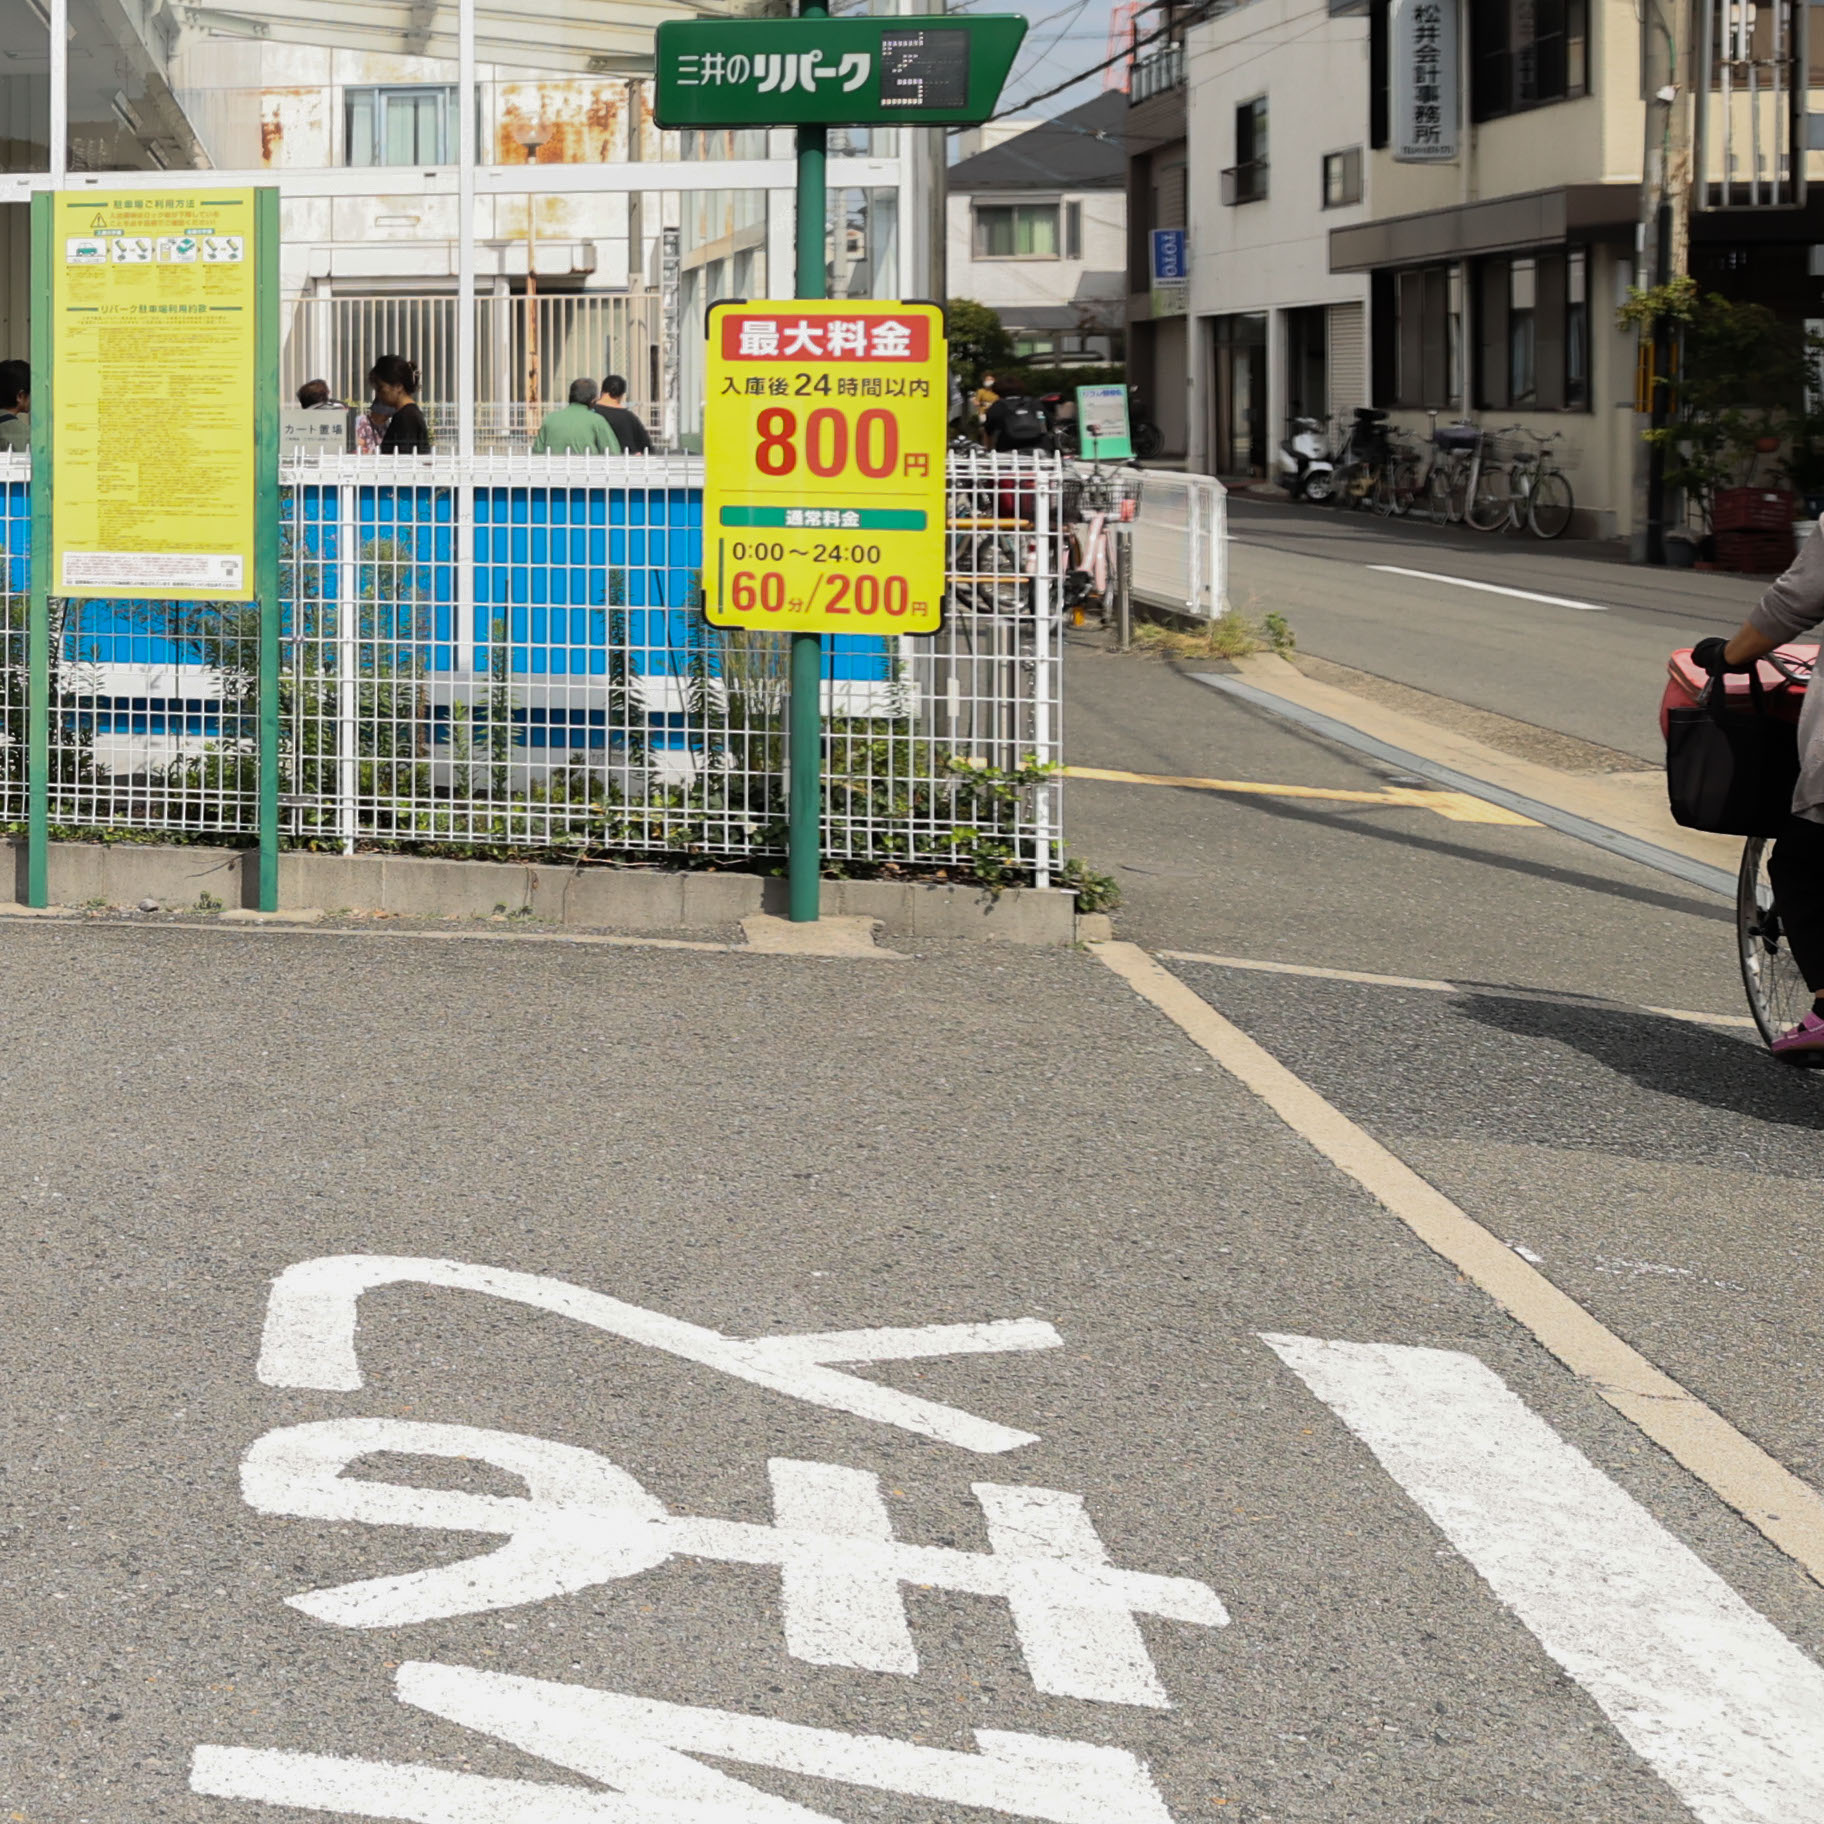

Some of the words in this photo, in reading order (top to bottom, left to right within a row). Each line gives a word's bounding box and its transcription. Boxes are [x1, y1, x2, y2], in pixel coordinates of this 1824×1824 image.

[676, 49, 872, 94] 三井のリパーク
[1413, 4, 1441, 144] 松井会計事務所
[1160, 232, 1178, 277] TOTO
[738, 320, 912, 357] 最大料金
[785, 509, 860, 528] 通常料金
